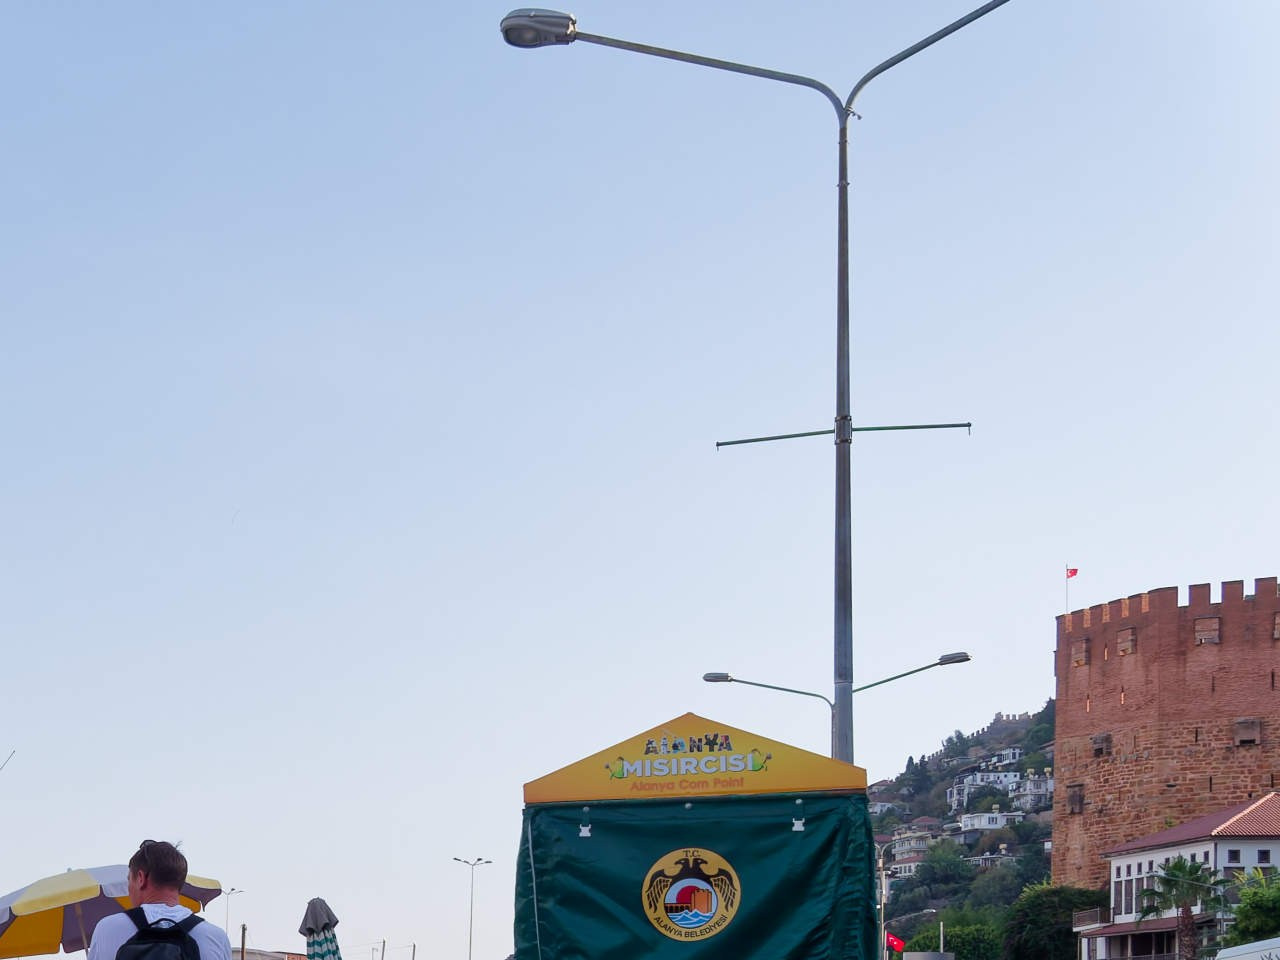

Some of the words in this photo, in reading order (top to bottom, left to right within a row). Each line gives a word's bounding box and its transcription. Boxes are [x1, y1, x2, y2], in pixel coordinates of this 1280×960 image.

[644, 733, 733, 755] ALANYA
[624, 753, 754, 778] MISIRCISI
[630, 781, 676, 792] Alanya
[713, 777, 745, 789] Point
[683, 850, 701, 858] T.C.
[654, 916, 683, 938] ALANYA
[684, 914, 728, 938] BELEDİYESİ
